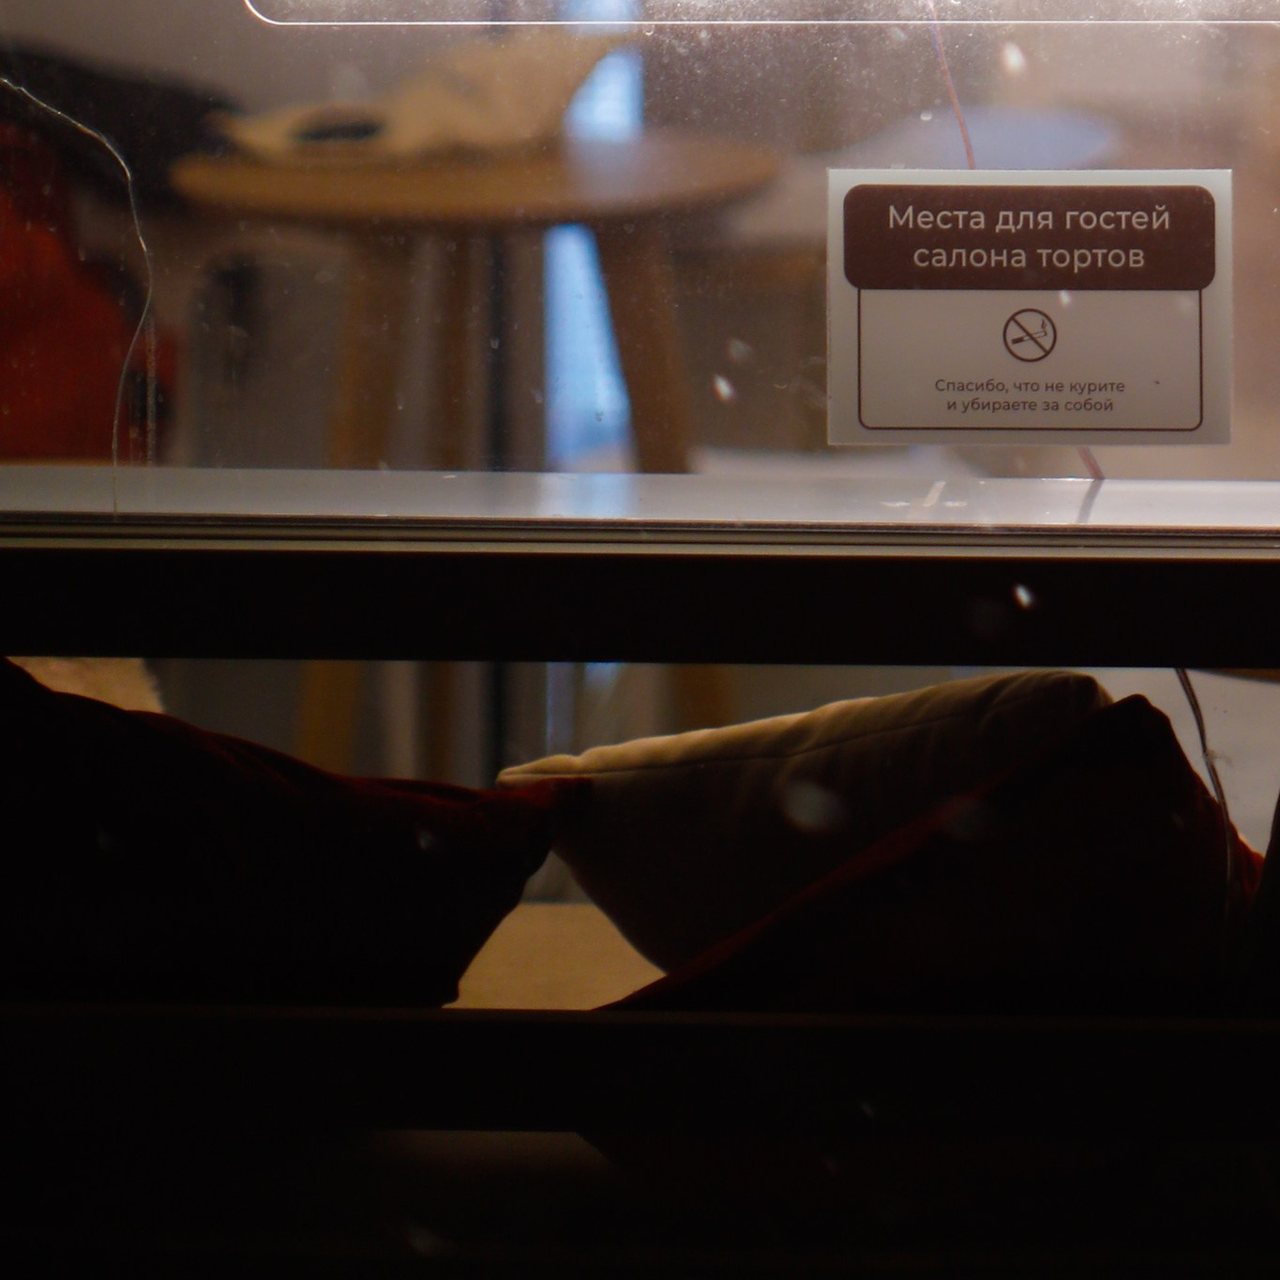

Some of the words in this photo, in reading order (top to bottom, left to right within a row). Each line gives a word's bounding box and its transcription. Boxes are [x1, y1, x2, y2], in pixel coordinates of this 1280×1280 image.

[888, 204, 986, 230] Места
[995, 209, 1054, 234] для
[1065, 204, 1171, 230] гостей
[913, 247, 1027, 268] салона
[1036, 248, 1145, 274] тортов
[934, 378, 1009, 394] Спасибо,
[1013, 381, 1041, 393] что
[1045, 381, 1065, 393] не
[1069, 381, 1126, 396] курите
[946, 400, 958, 412] и
[961, 397, 1038, 414] убираете
[1042, 400, 1060, 412] за
[1063, 397, 1114, 412] собой
